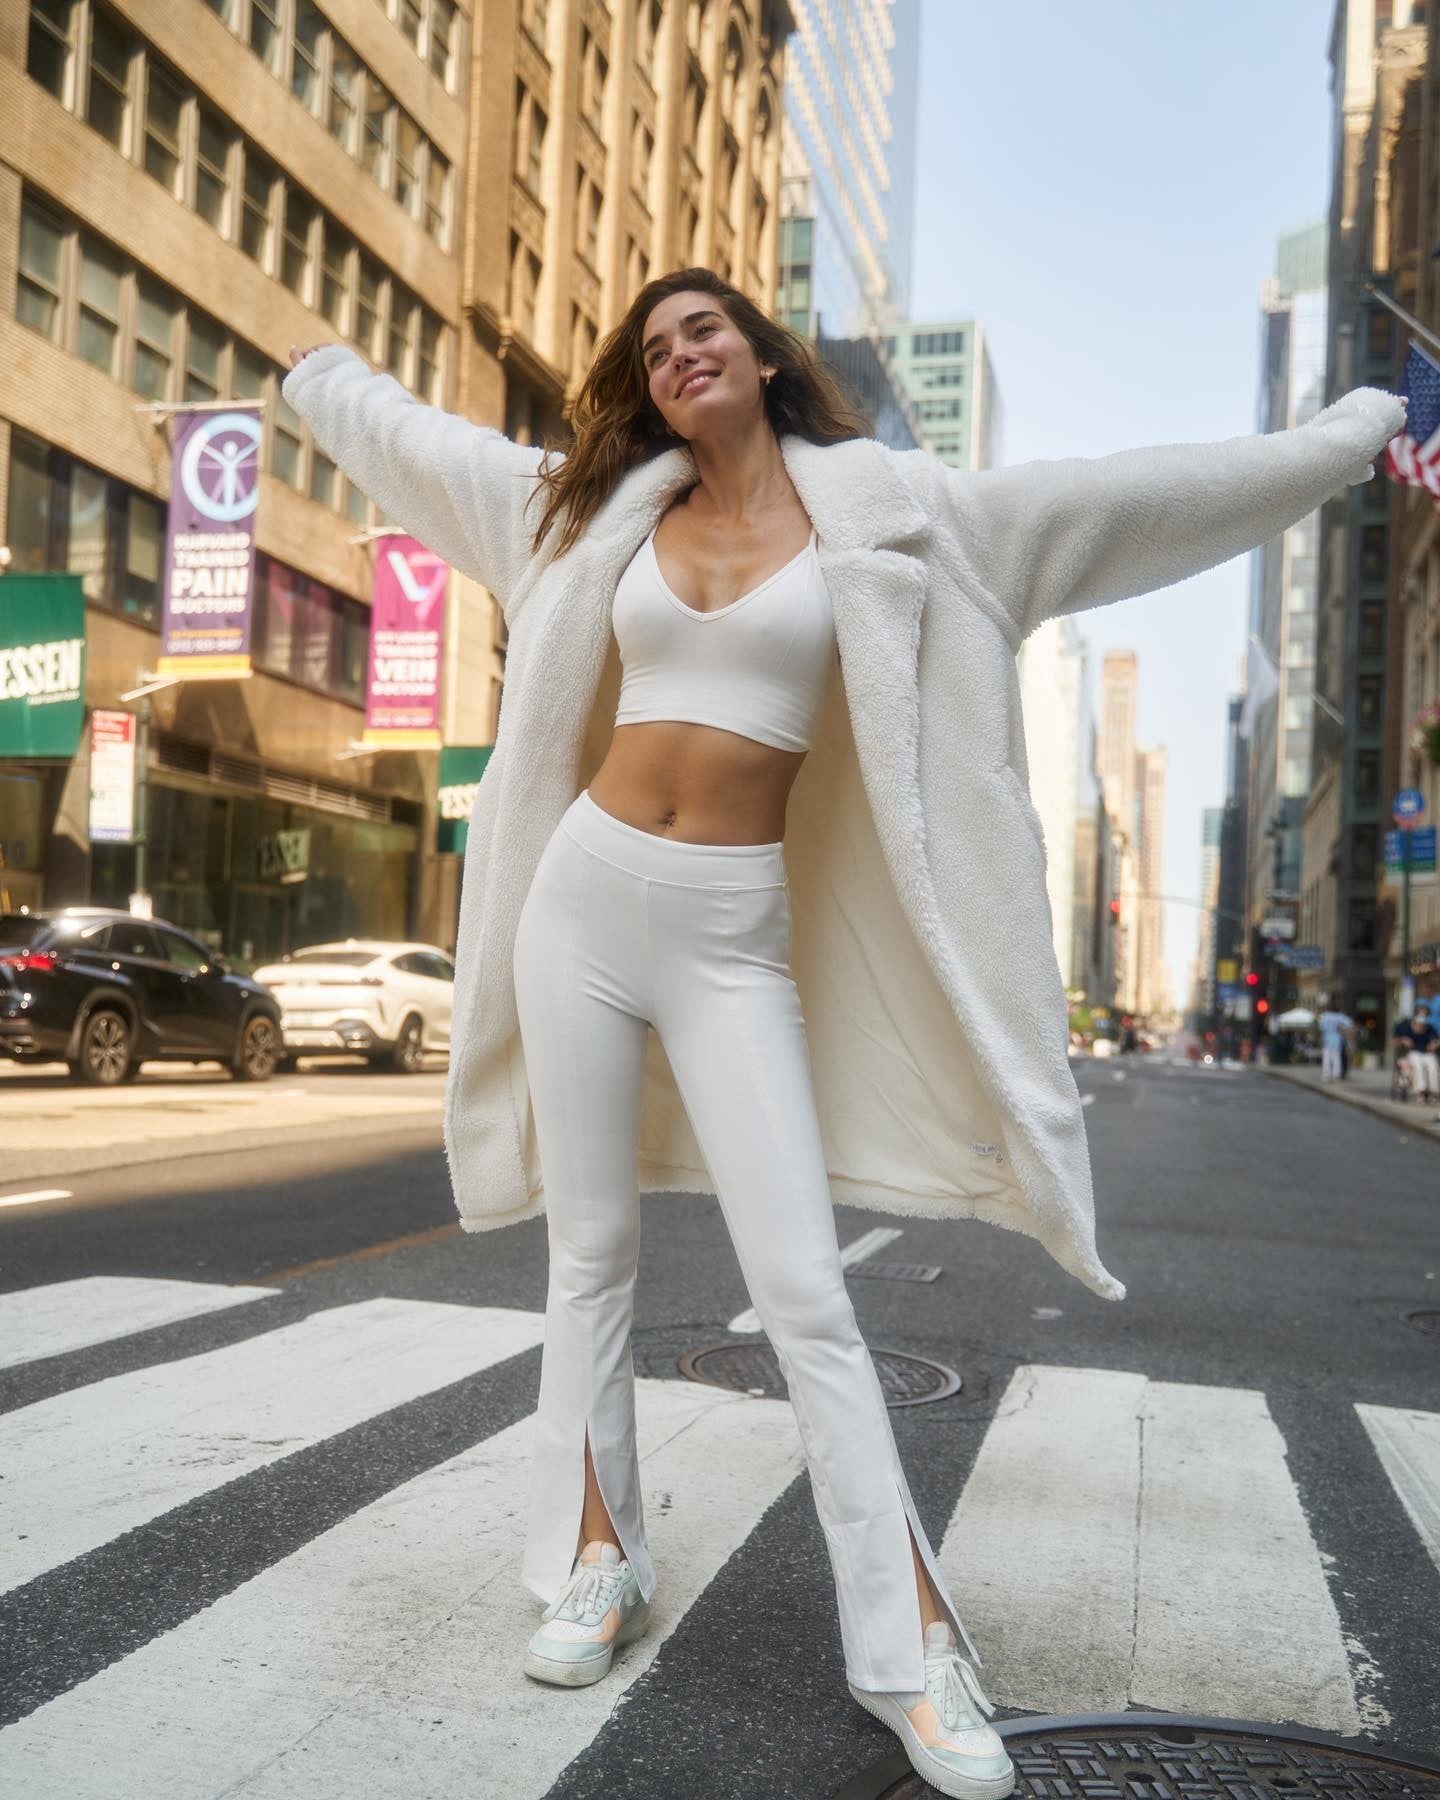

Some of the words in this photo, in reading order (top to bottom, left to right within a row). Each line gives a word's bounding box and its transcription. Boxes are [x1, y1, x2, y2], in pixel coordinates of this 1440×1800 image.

[174, 533, 250, 550] HARVARD
[173, 550, 249, 567] TRAINED
[171, 567, 249, 597] PAIN
[170, 597, 246, 614] DOCTORS
[376, 644, 437, 657] TRAINED
[374, 658, 437, 682] VEIN
[372, 682, 436, 696] DOCTORS
